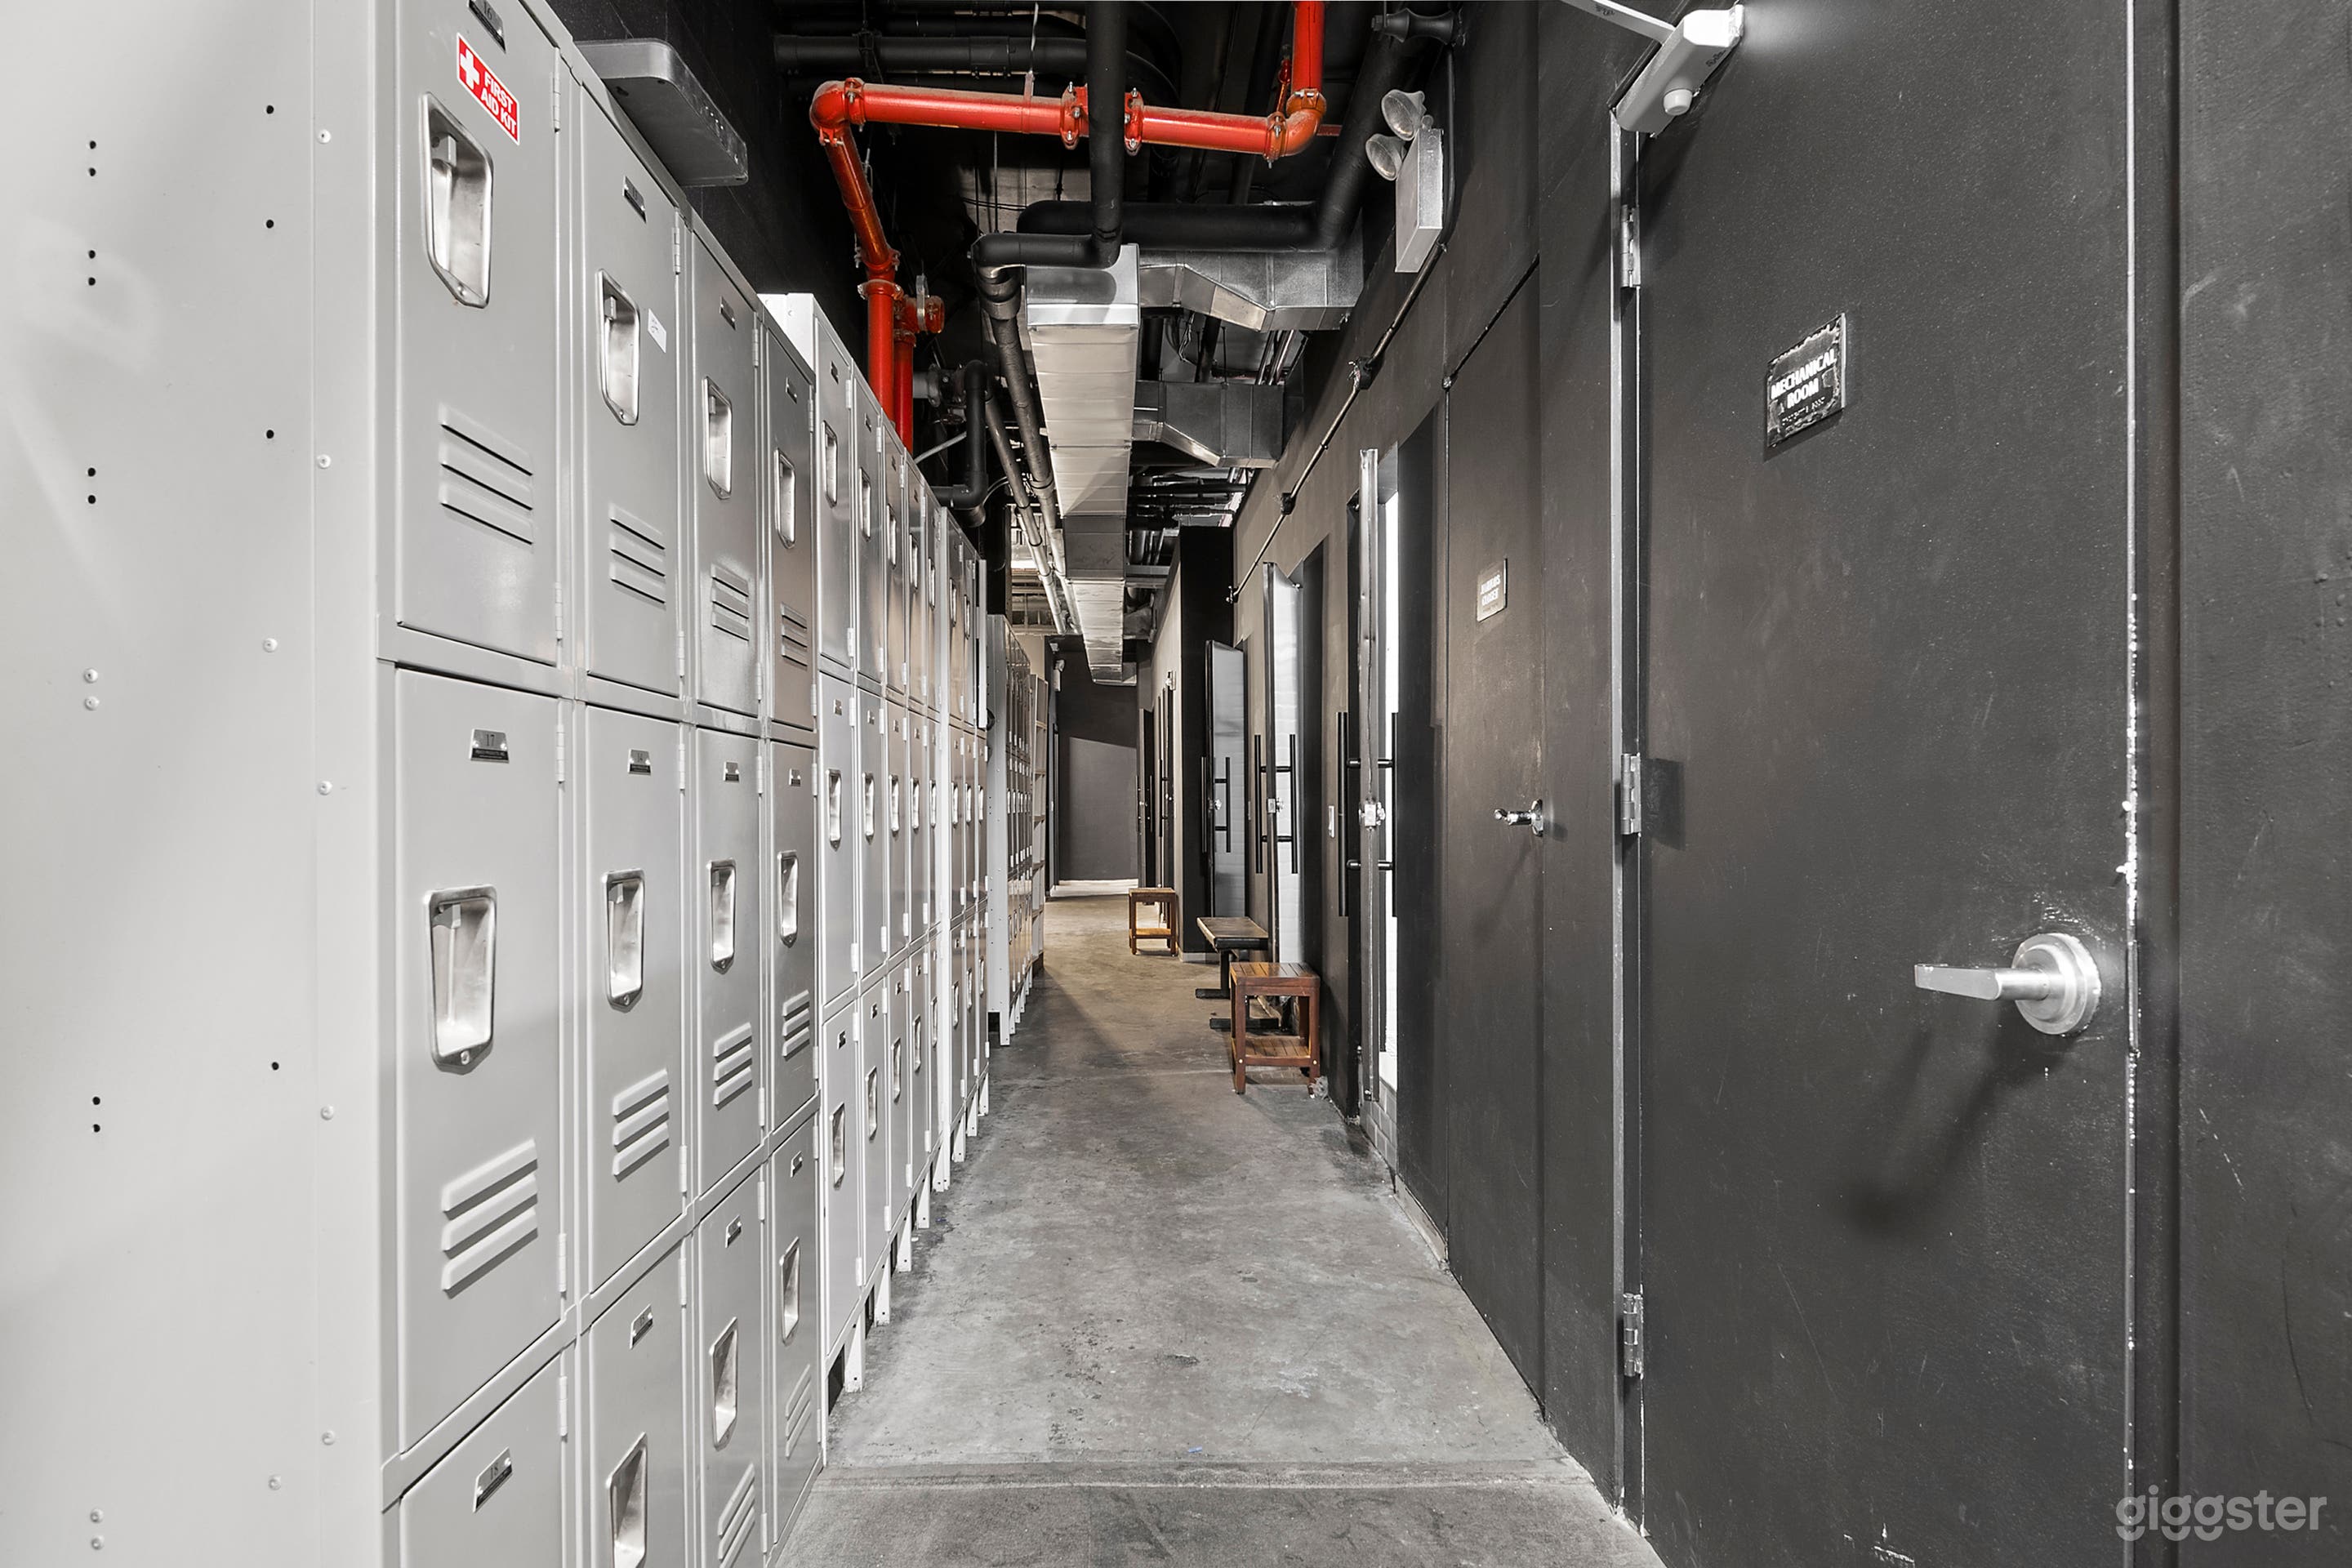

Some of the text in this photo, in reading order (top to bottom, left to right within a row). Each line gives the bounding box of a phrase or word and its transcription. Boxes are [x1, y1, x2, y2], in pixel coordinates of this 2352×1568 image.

[480, 87, 517, 135] AID KIT
[484, 71, 514, 114] FIRST
[1771, 348, 1838, 400] MECHANICAL
[1787, 377, 1820, 409] ROOM
[486, 733, 495, 746] 17
